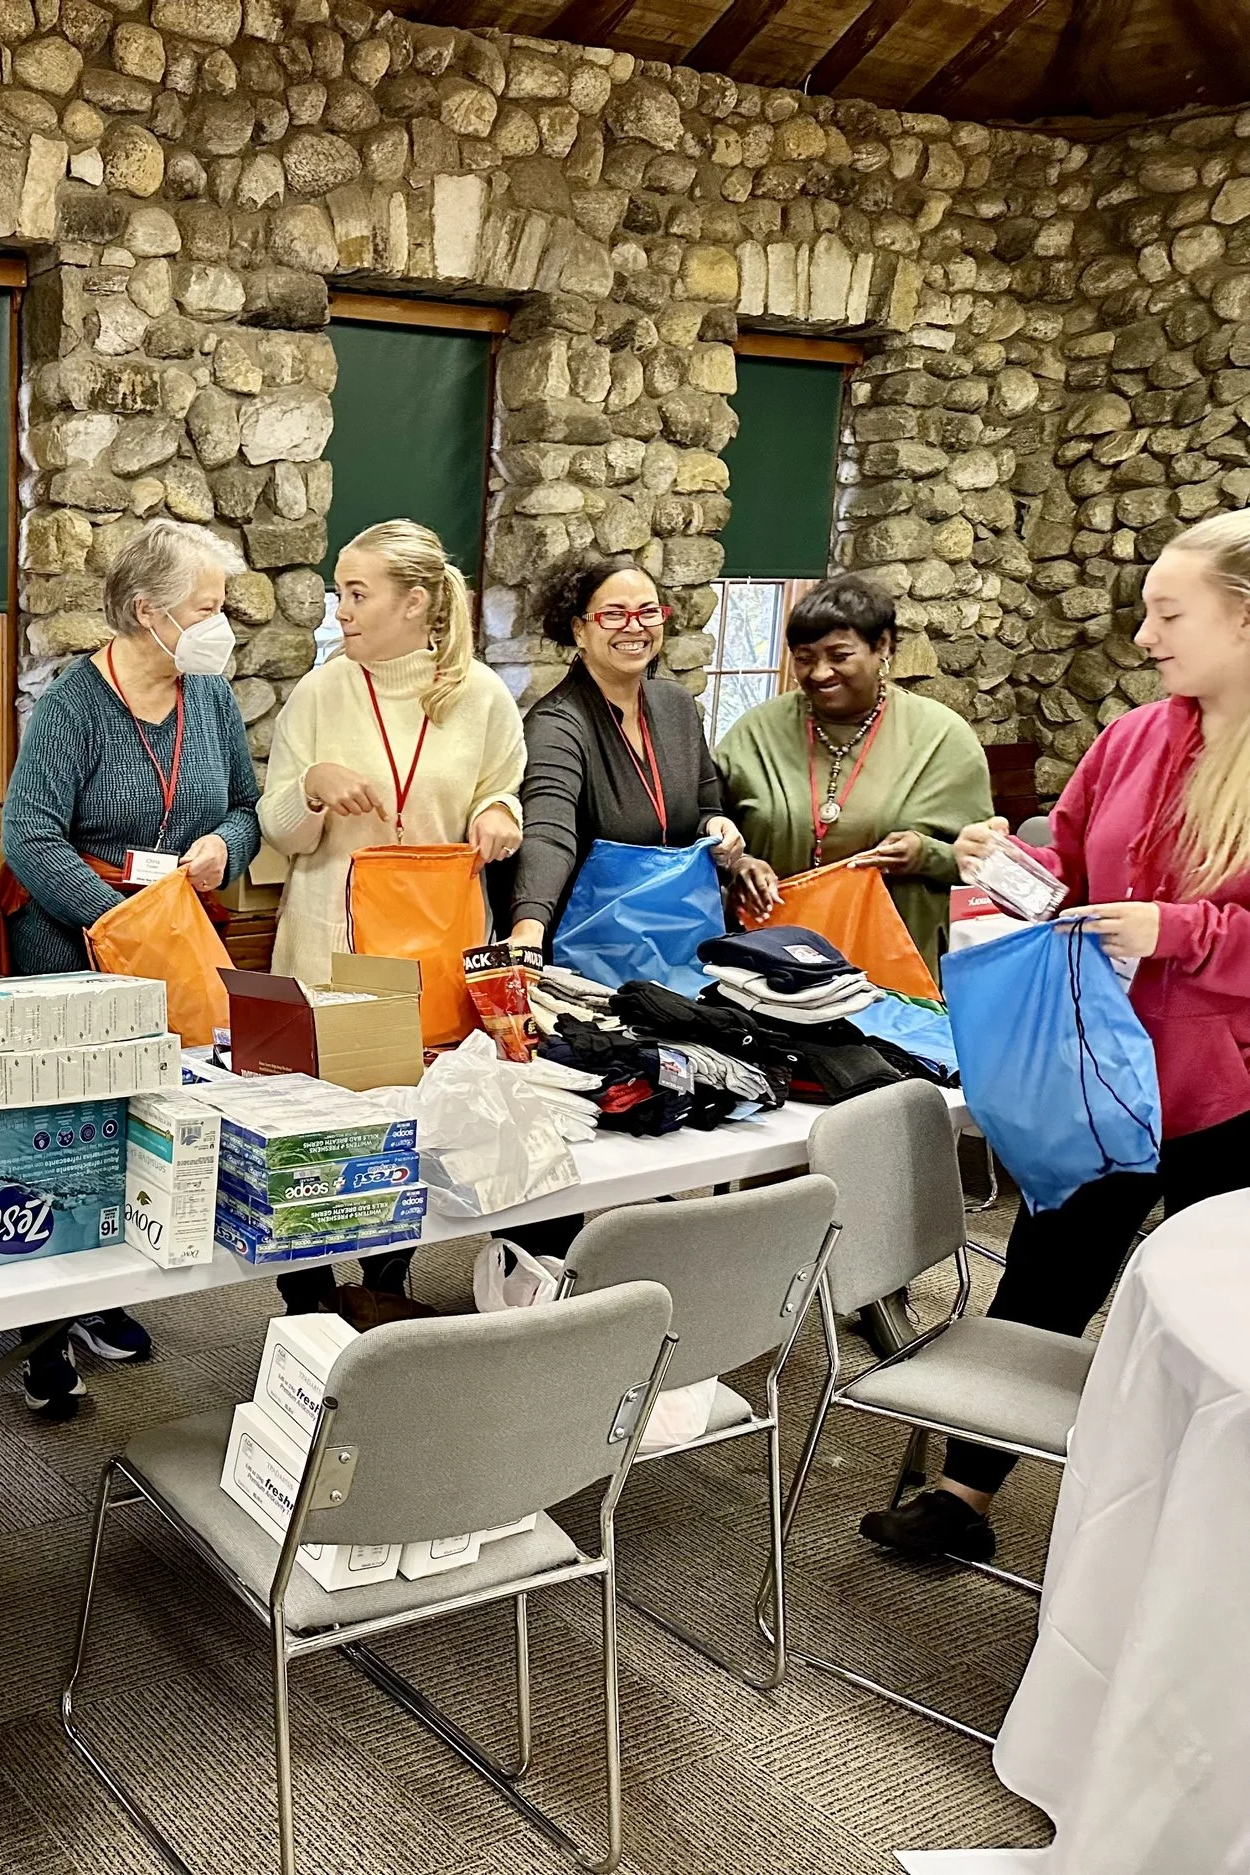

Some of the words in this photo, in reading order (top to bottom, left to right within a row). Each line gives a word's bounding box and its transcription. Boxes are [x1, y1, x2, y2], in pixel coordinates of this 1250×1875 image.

[392, 1130, 414, 1138] scope
[303, 1140, 323, 1148] GERMS
[324, 1137, 346, 1146] BREATH
[346, 1140, 372, 1150] WHITENS
[309, 1144, 340, 1153] FRESHENS
[138, 1150, 166, 1173] sensitive
[354, 1166, 410, 1188] Crest
[285, 1182, 329, 1199] scope
[402, 1197, 424, 1205] scope
[311, 1208, 332, 1218] GERMS
[333, 1205, 354, 1214] BREATH
[355, 1209, 381, 1218] WHITENS
[317, 1213, 349, 1223] FRESHENS
[101, 1220, 118, 1236] 16
[124, 1203, 164, 1250] Dove
[217, 1226, 248, 1254] Cres
